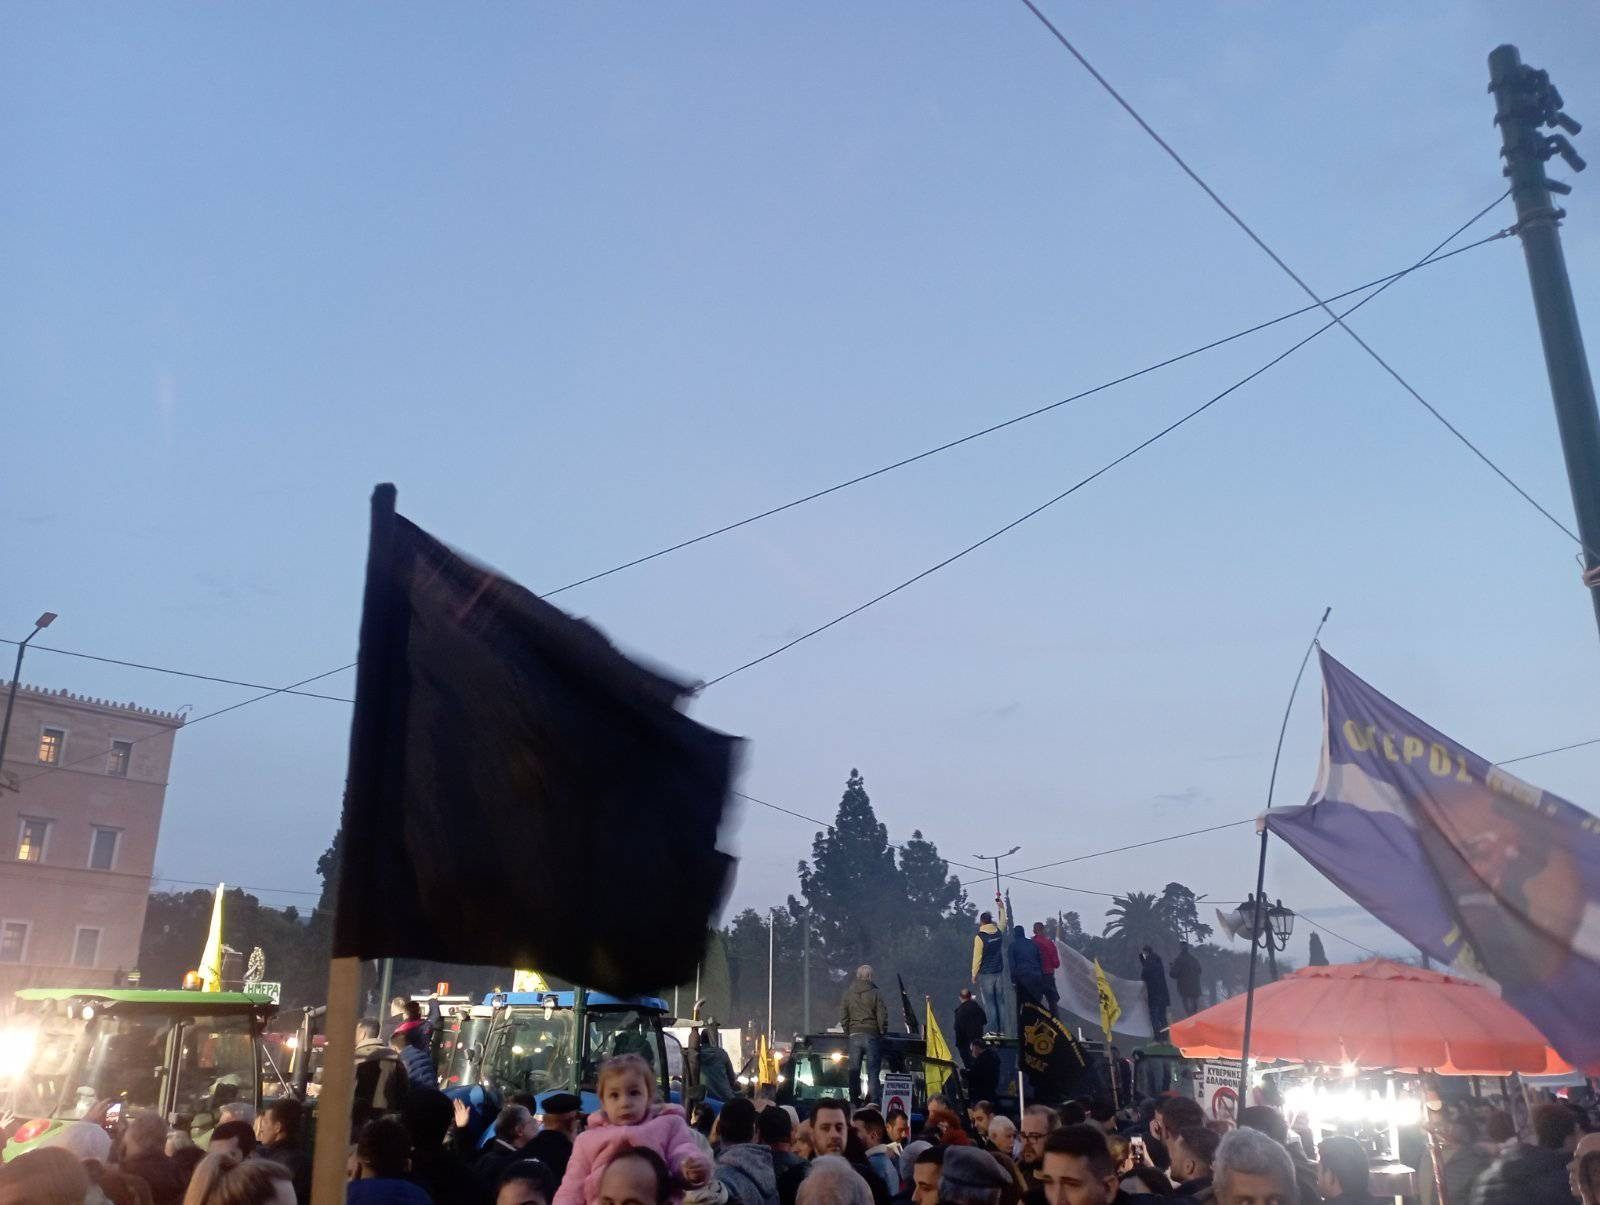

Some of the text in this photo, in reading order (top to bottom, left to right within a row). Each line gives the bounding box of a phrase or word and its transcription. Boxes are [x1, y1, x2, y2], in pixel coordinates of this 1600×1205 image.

[248, 983, 279, 996] ΗΜΕΡΑ
[1207, 1067, 1241, 1079] ΚΥΒΕΡΝΗΣ
[1206, 1076, 1241, 1087] ΔΟΛΟΦΟΝ
